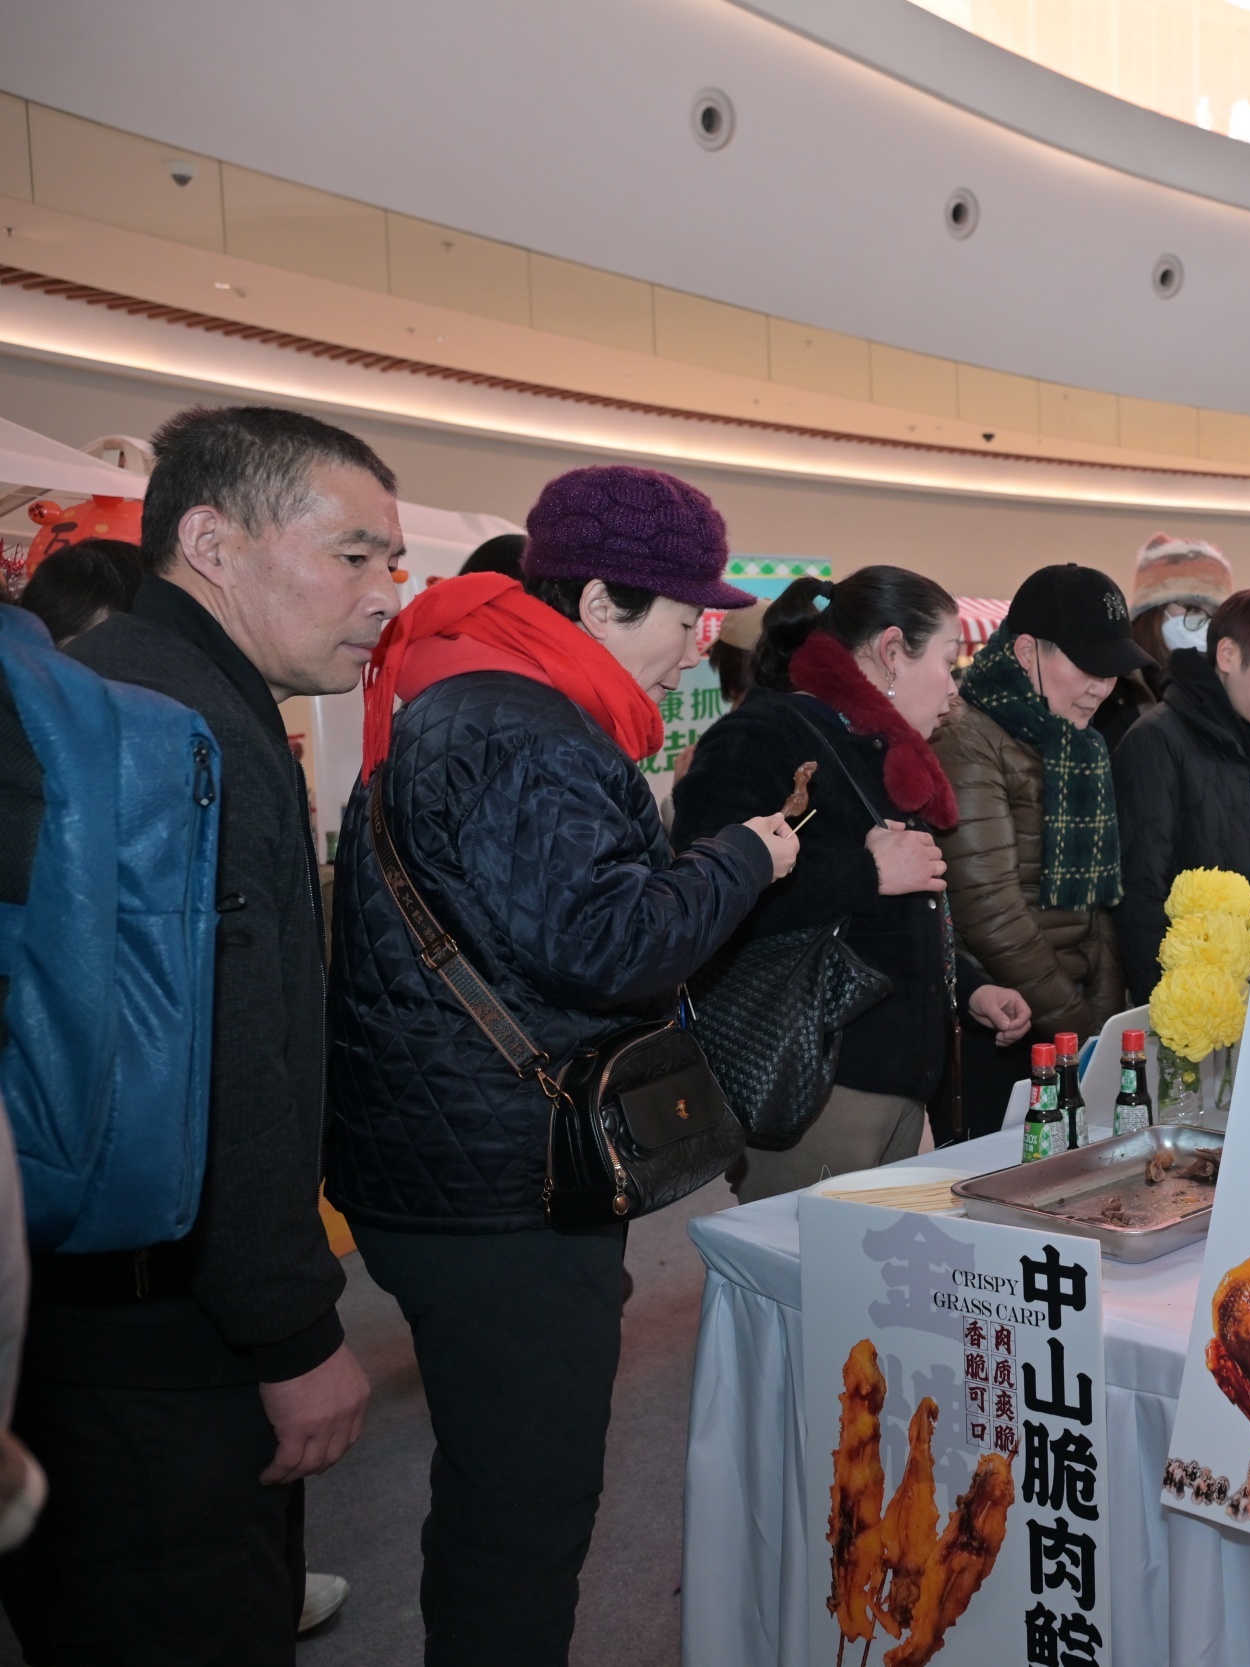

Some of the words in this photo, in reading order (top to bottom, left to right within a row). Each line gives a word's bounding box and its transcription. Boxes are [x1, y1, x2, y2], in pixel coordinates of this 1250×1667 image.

[933, 1291, 992, 1318] GRASS
[996, 1303, 1046, 1328] CARP
[952, 1269, 1019, 1296] CRISPY
[964, 1320, 989, 1442] 香脆可口
[993, 1325, 1018, 1455] 肉质爽脆
